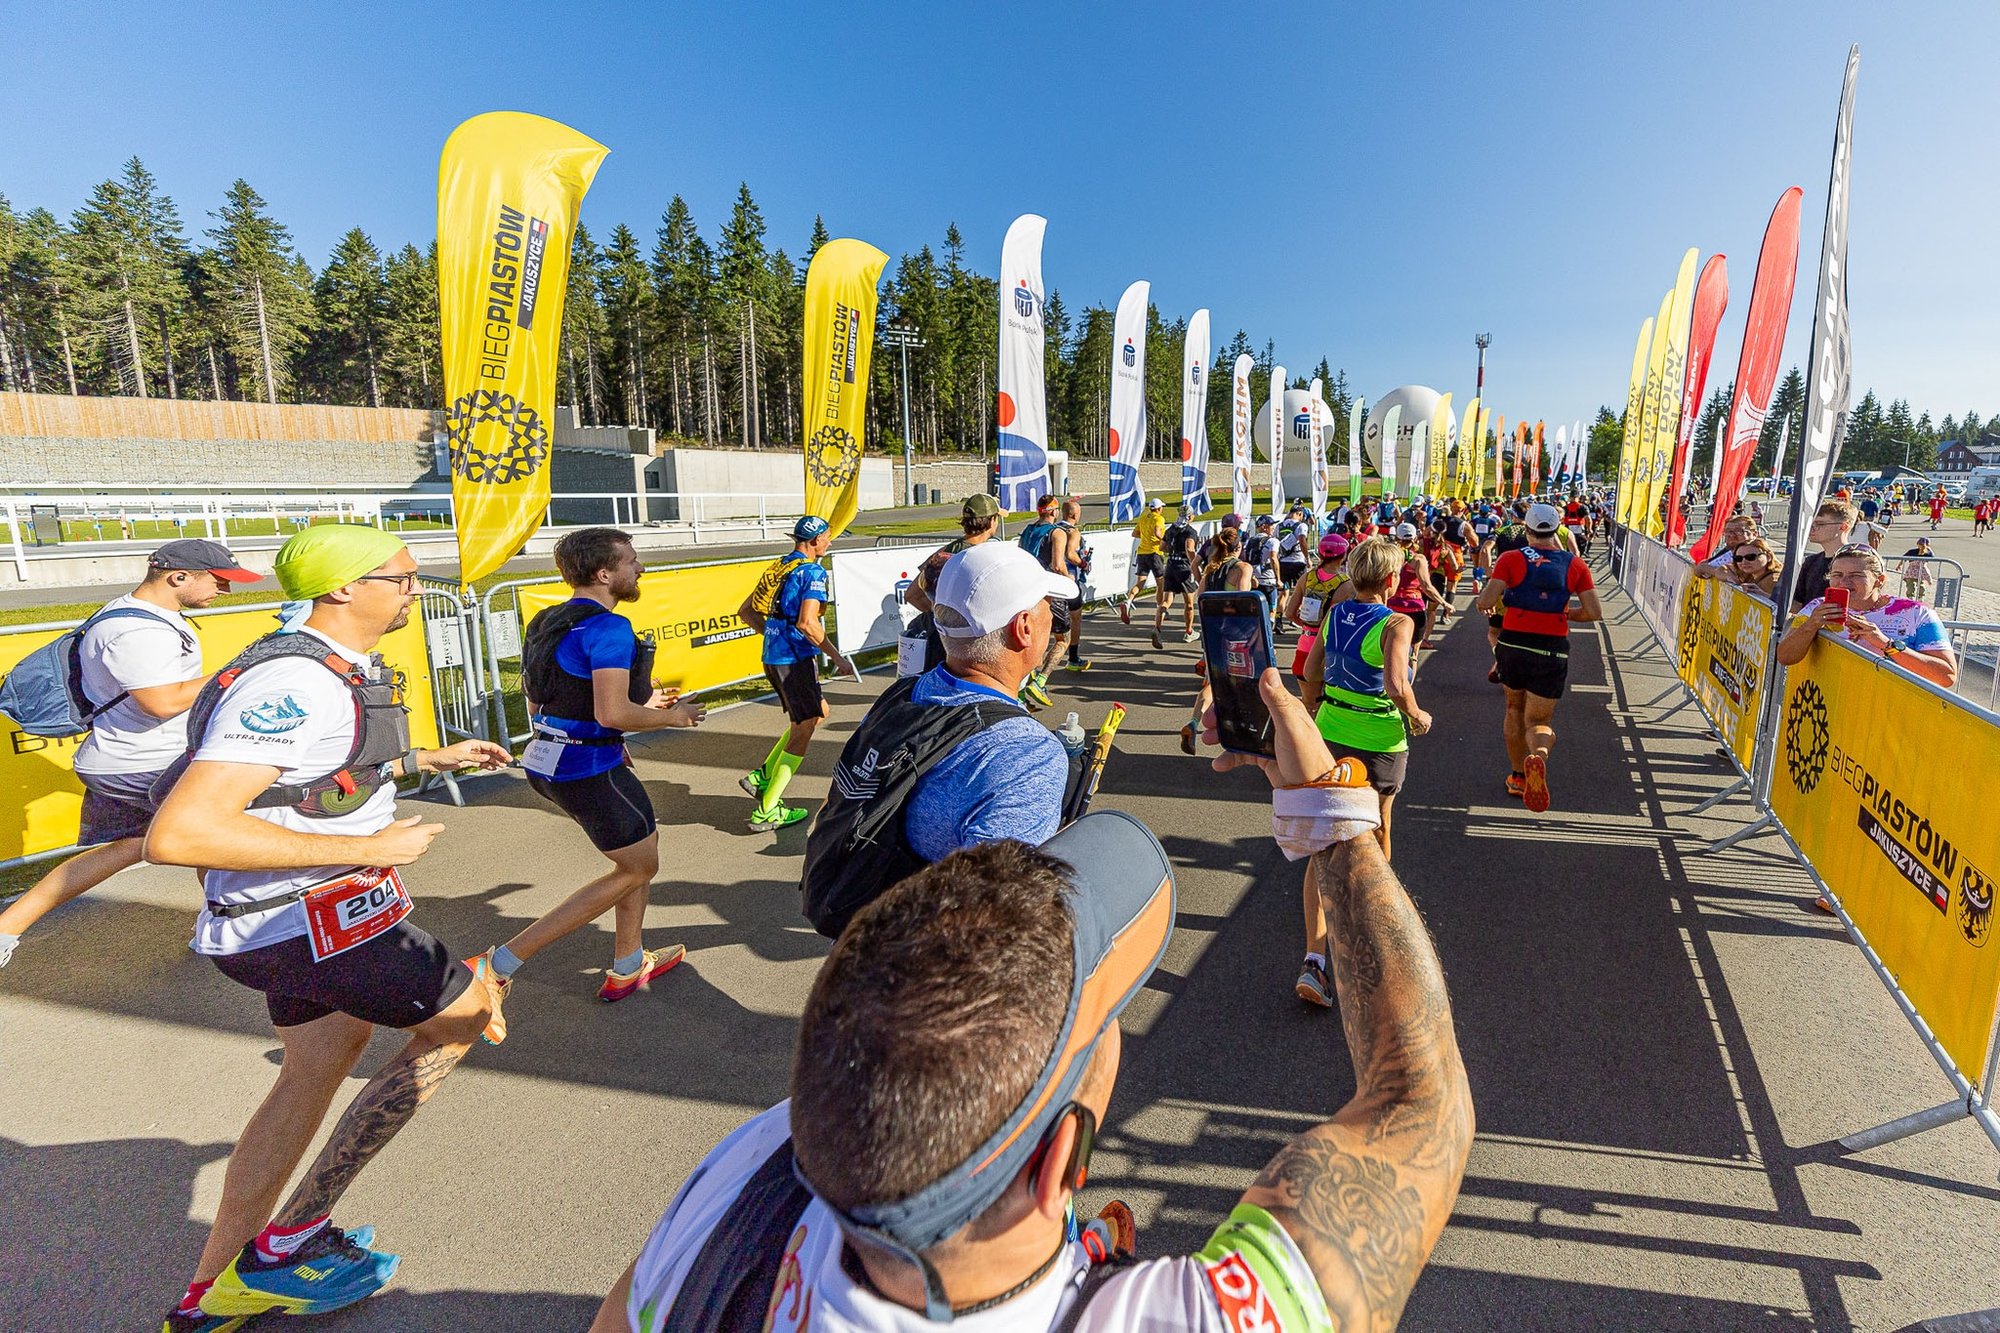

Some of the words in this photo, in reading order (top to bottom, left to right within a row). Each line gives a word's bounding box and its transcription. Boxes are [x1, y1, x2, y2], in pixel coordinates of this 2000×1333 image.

[480, 204, 525, 380] BIEGPIASTÓW
[522, 236, 543, 312] JAKUSZYCE
[826, 302, 848, 420] BIEGPIASTÓW
[846, 319, 857, 372] JAKUSZYCE
[224, 733, 255, 741] ULTRA
[258, 735, 296, 745] DZIADY
[1831, 745, 1958, 880] BIEGPIASTÓW
[1869, 823, 1932, 893] JAKUSZYCE
[346, 880, 395, 920] 204
